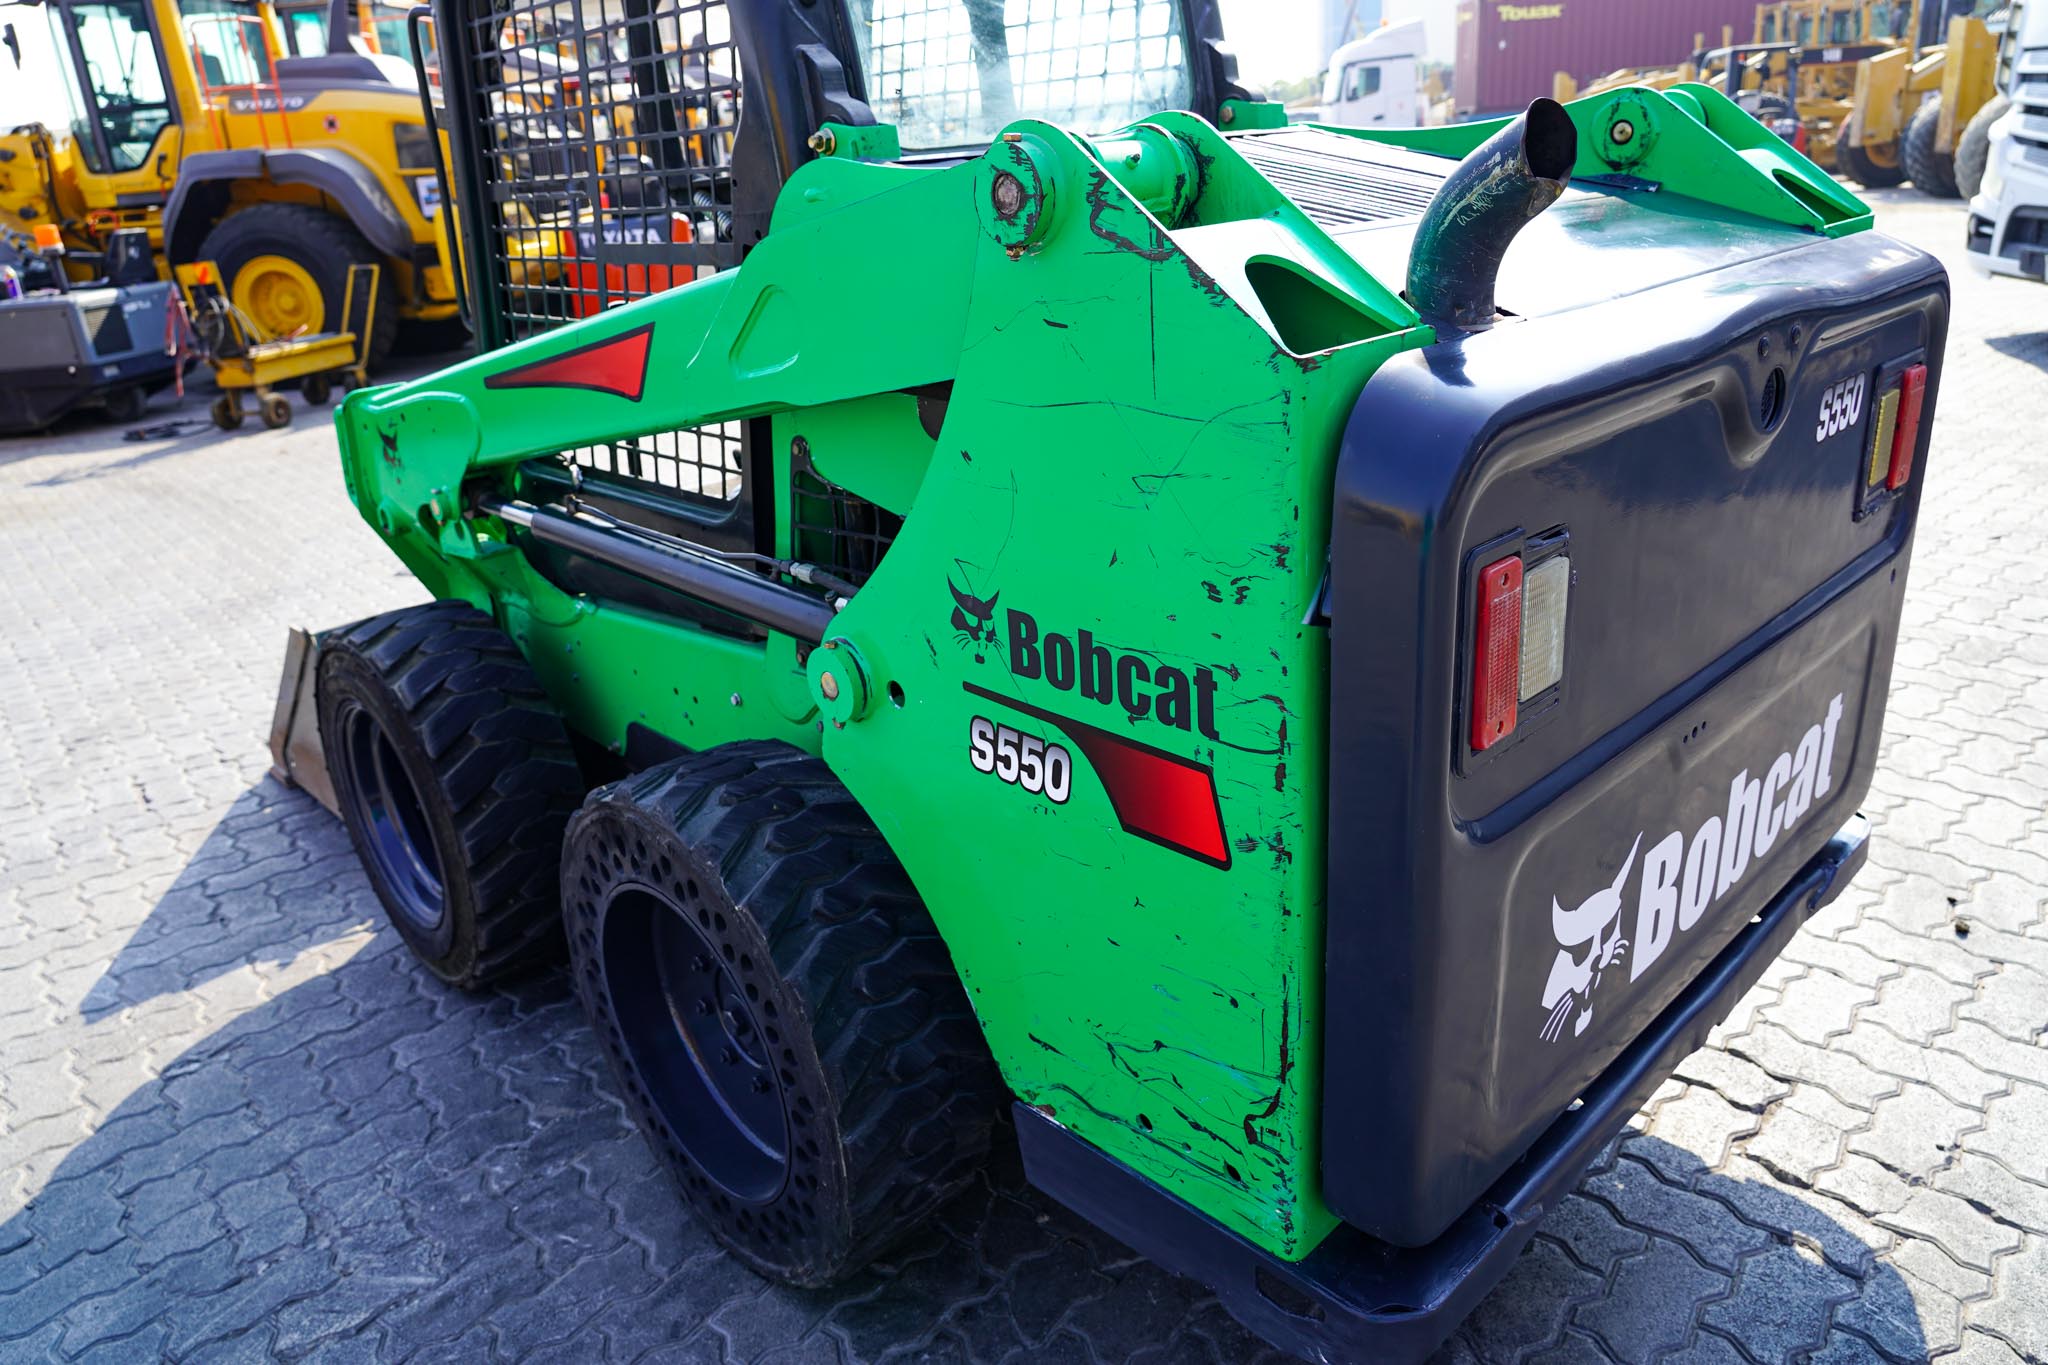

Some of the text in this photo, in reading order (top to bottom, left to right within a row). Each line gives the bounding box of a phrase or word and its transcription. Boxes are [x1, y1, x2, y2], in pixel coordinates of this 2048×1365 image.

[1816, 372, 1865, 443] S550
[1006, 608, 1219, 741] Bobcat
[969, 714, 1072, 805] S550
[1629, 692, 1843, 984] Bobcat
